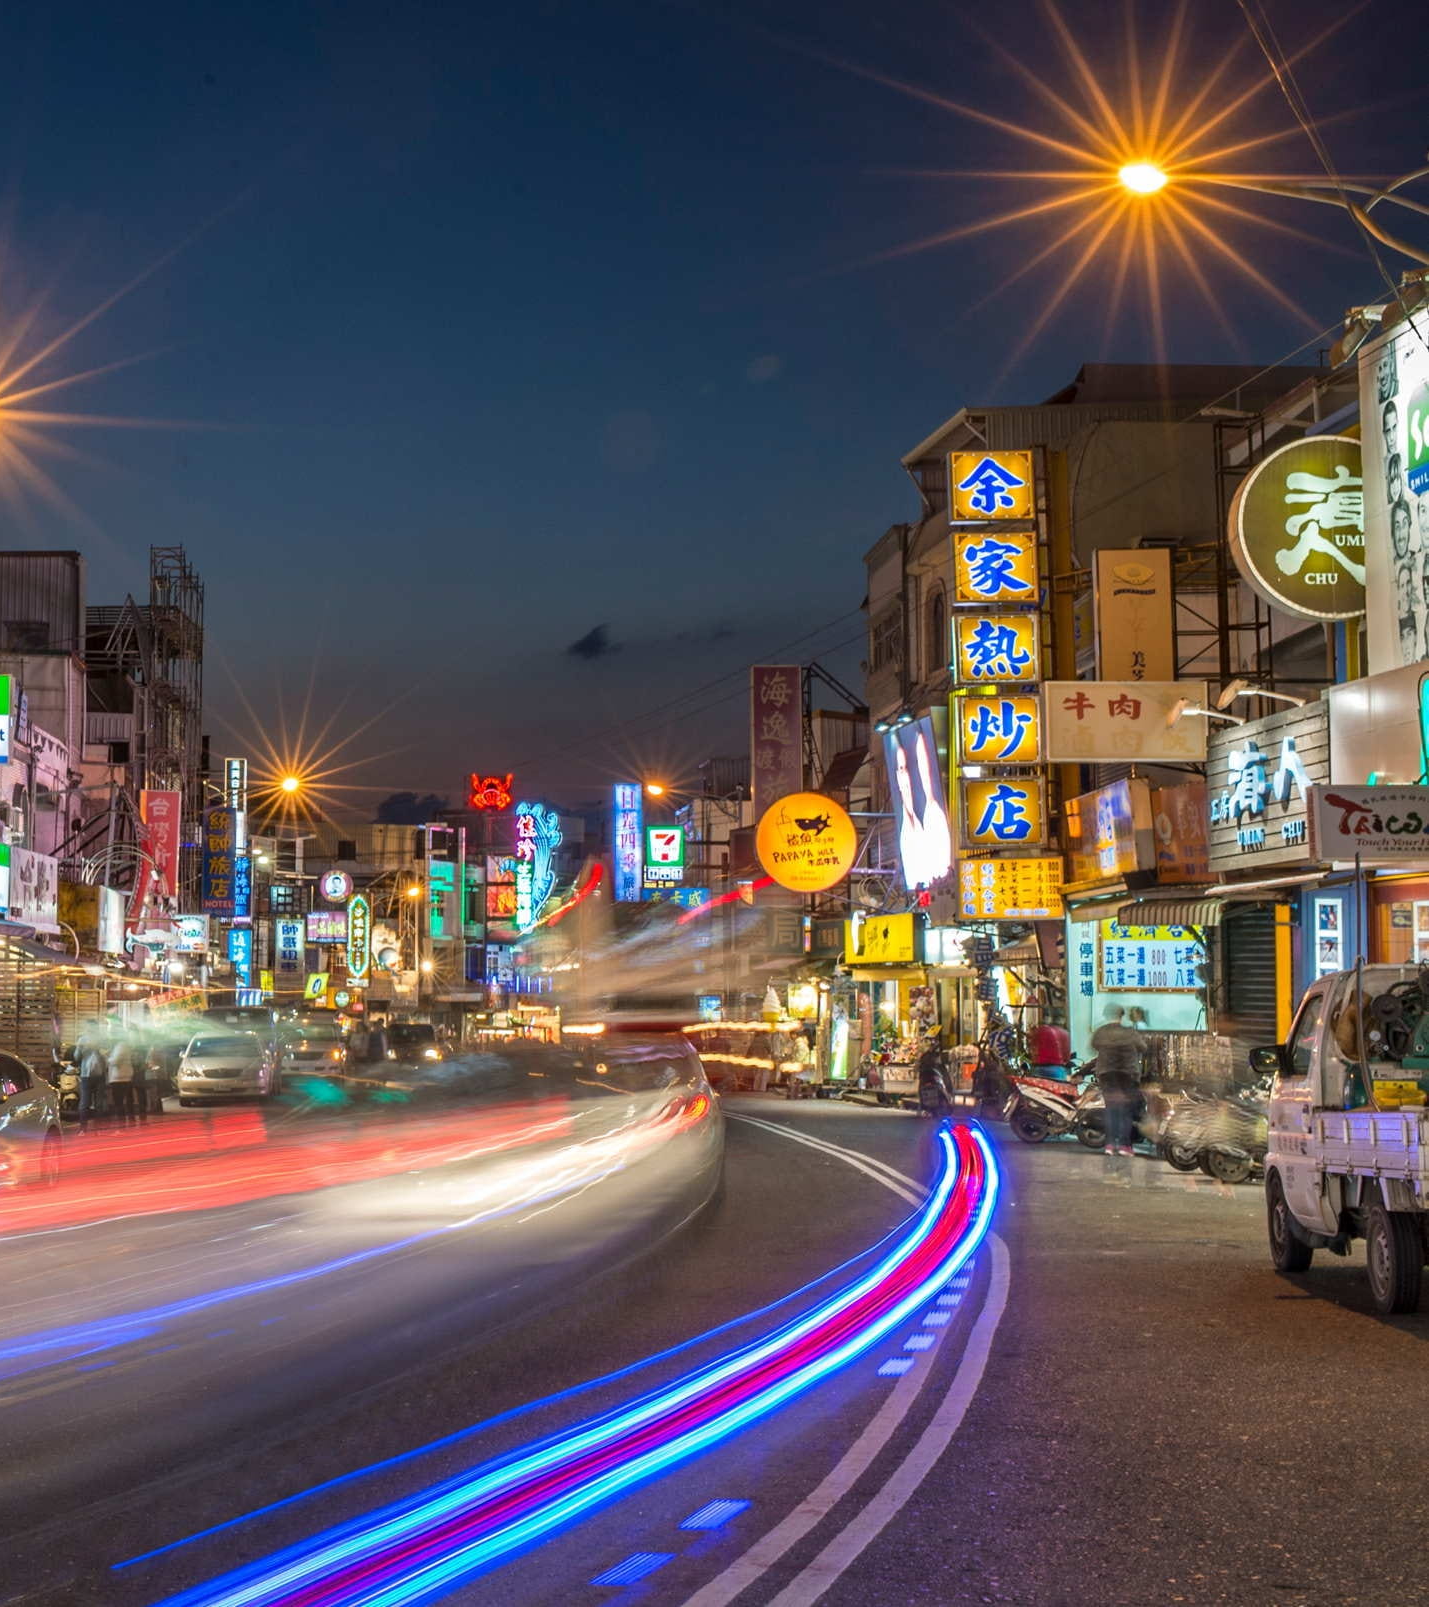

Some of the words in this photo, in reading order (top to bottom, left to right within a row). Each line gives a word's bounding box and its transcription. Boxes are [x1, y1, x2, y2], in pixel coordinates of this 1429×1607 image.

[1304, 572, 1339, 585] CHU
[957, 457, 1035, 840] 余家熱炒店
[1281, 819, 1305, 840] CHU
[1356, 838, 1390, 847] Touch
[1392, 838, 1420, 847] Your
[772, 849, 814, 864] PAPAYA
[204, 900, 233, 909] HOTEL
[1151, 949, 1166, 966] 800
[1148, 969, 1168, 987] 1000
